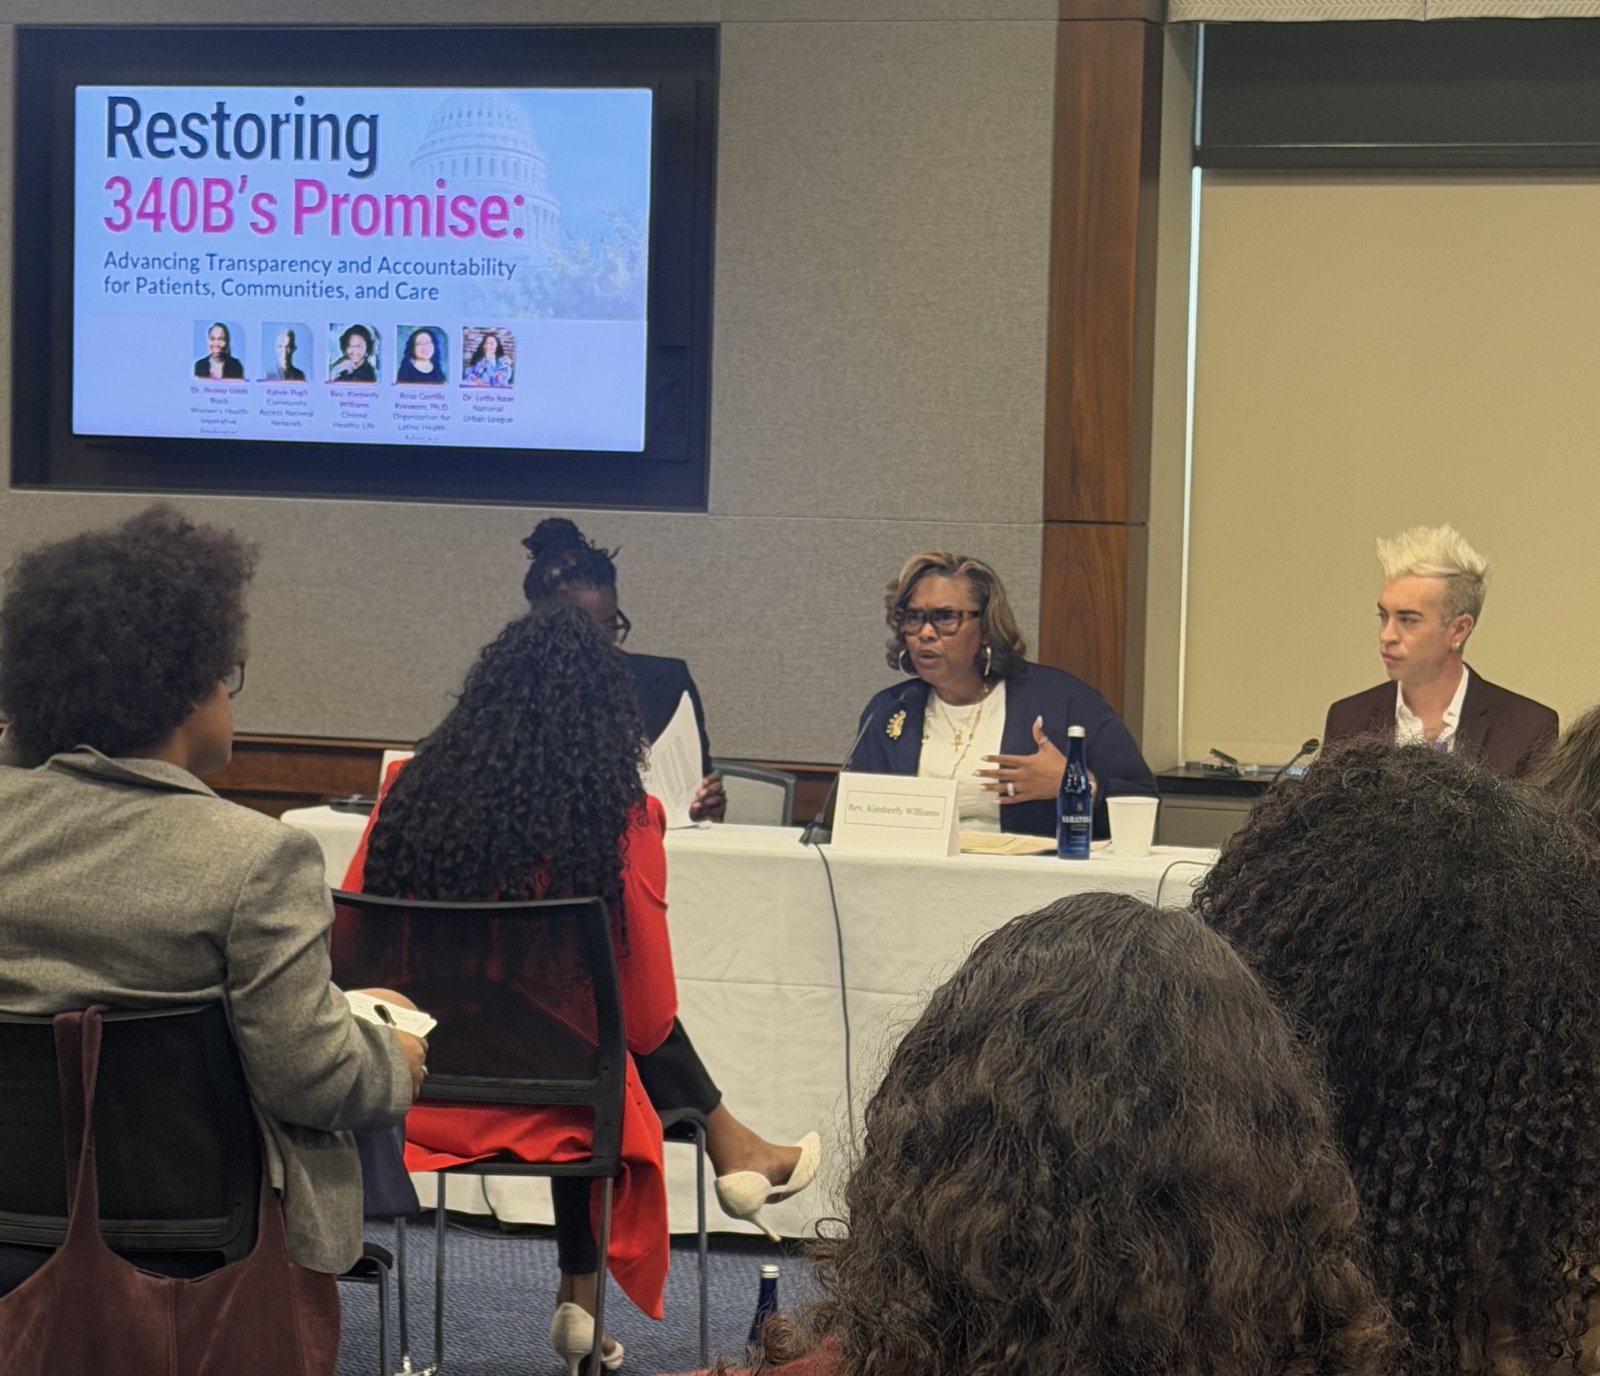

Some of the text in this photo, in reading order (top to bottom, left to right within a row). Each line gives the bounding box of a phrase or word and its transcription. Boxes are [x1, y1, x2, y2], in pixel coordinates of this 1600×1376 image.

[107, 95, 379, 179] Restoring
[104, 175, 525, 239] 340B's Promise:
[104, 251, 517, 280] Advancing Transparency and Accountability
[104, 276, 440, 301] for Patients, Communities, and Care
[848, 803, 941, 818] Rev. Kimberly Williams
